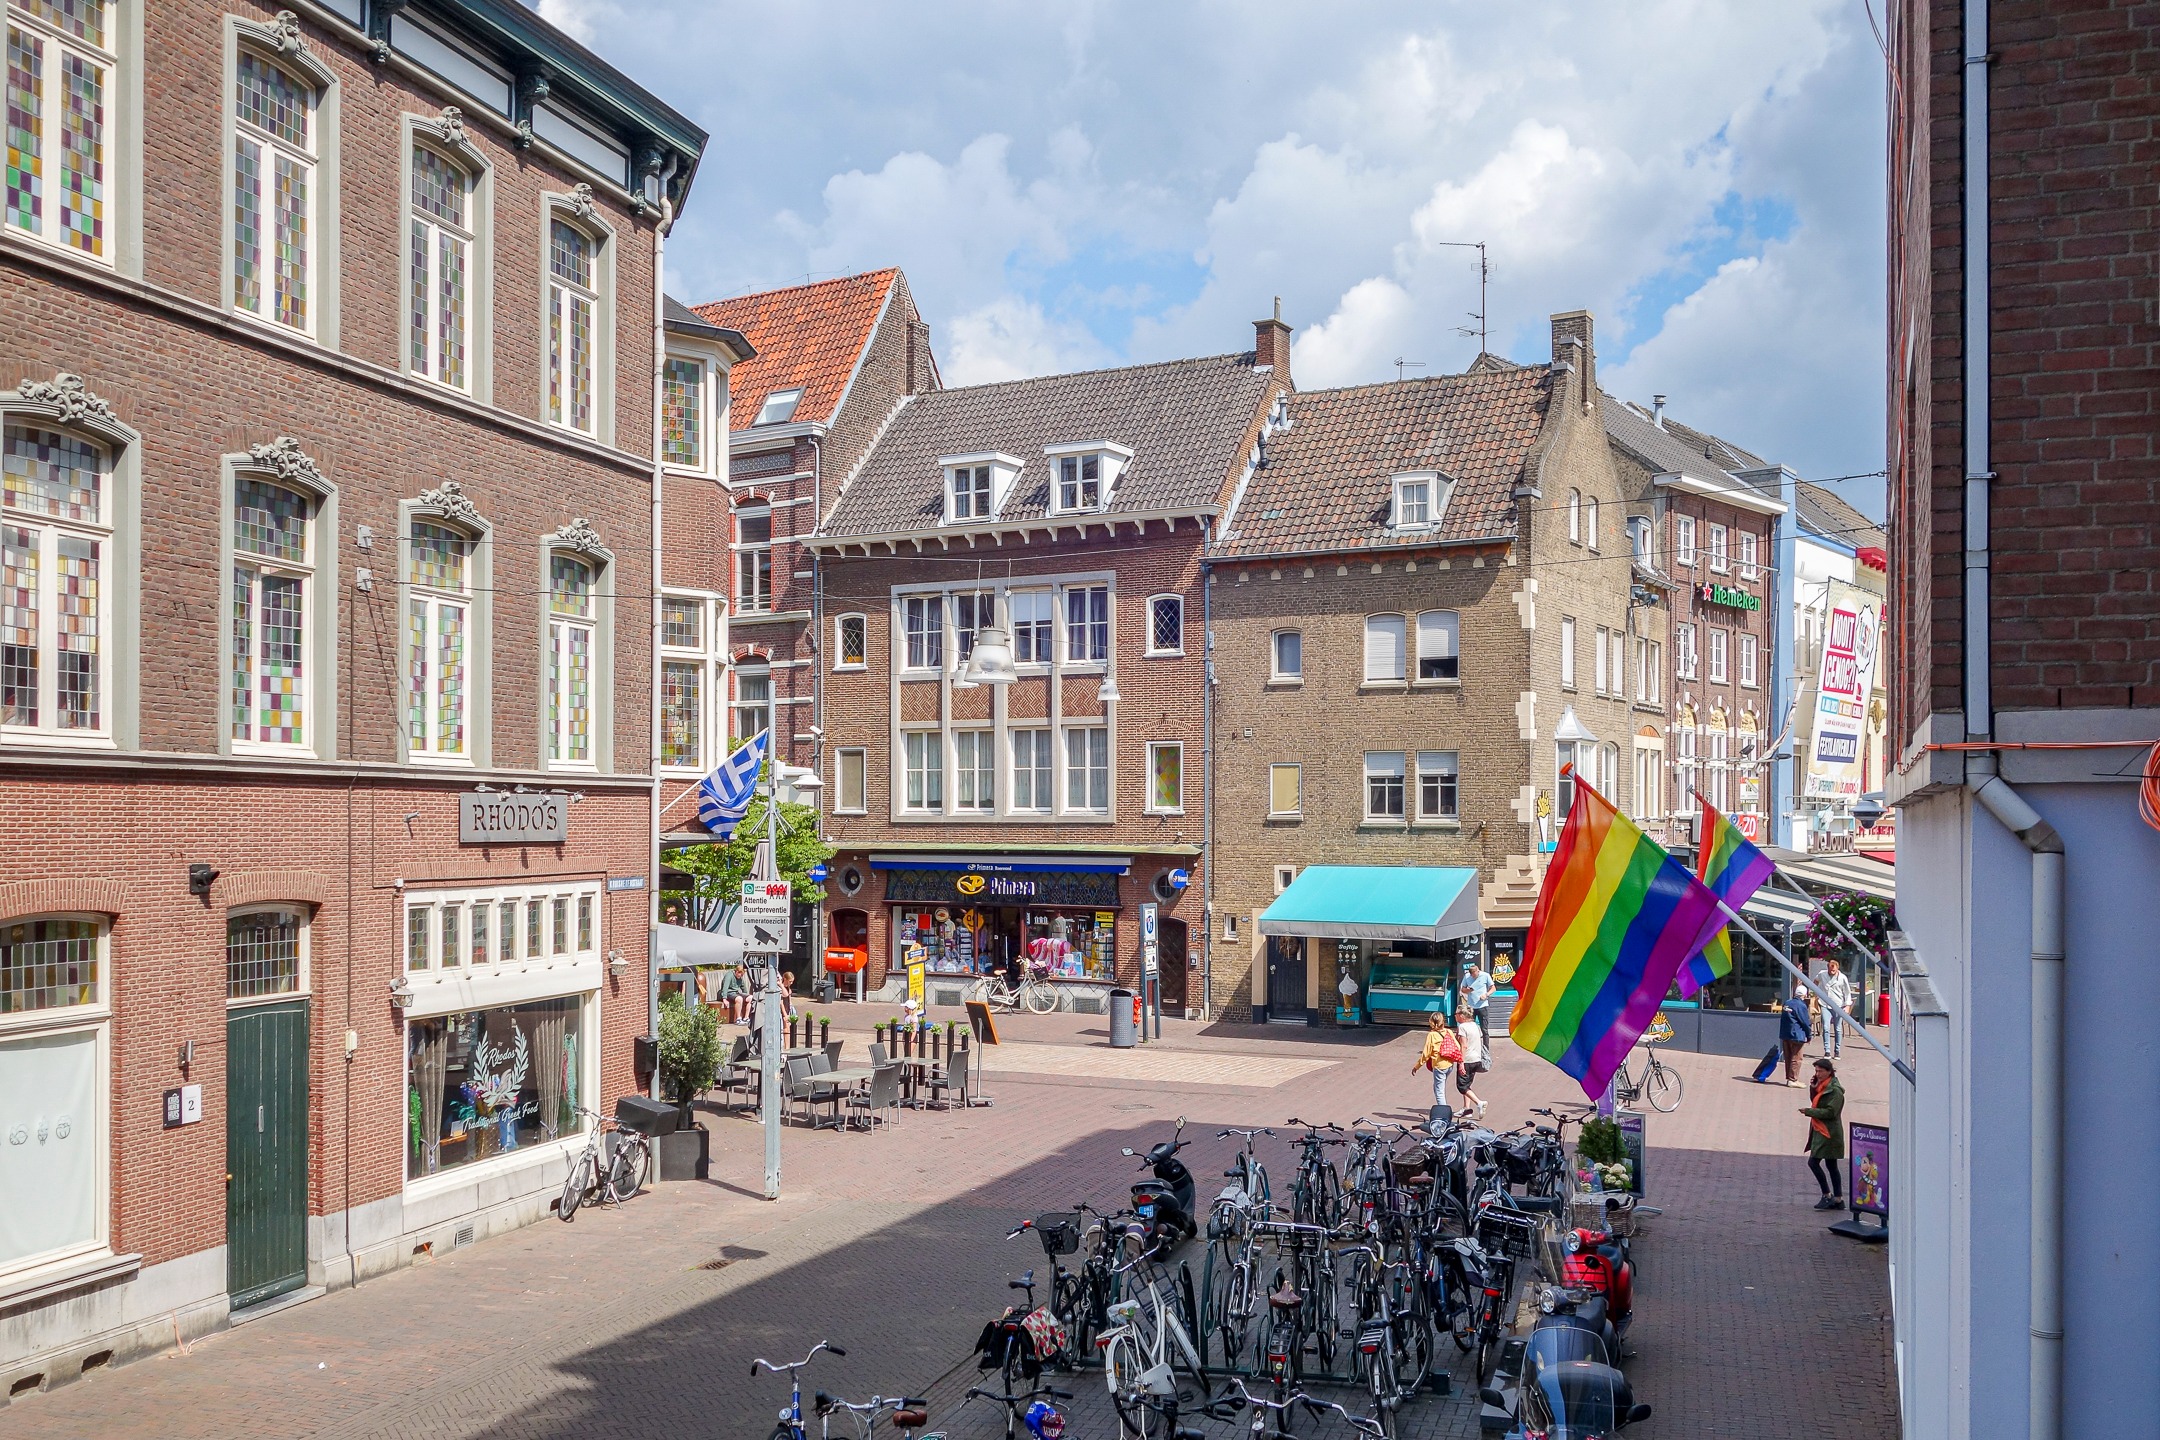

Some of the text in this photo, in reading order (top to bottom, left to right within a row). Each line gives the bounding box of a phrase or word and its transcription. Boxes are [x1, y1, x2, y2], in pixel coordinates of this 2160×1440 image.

[1714, 584, 1761, 611] Heineken
[1831, 613, 1856, 650] NOOIT
[473, 804, 557, 831] RHODOS
[991, 877, 1035, 896] Primera
[743, 906, 787, 914] Buurtpreventie
[487, 1047, 516, 1067] Rhodos
[188, 1100, 195, 1111] 2
[463, 1101, 539, 1132] Traditional Greek Food
